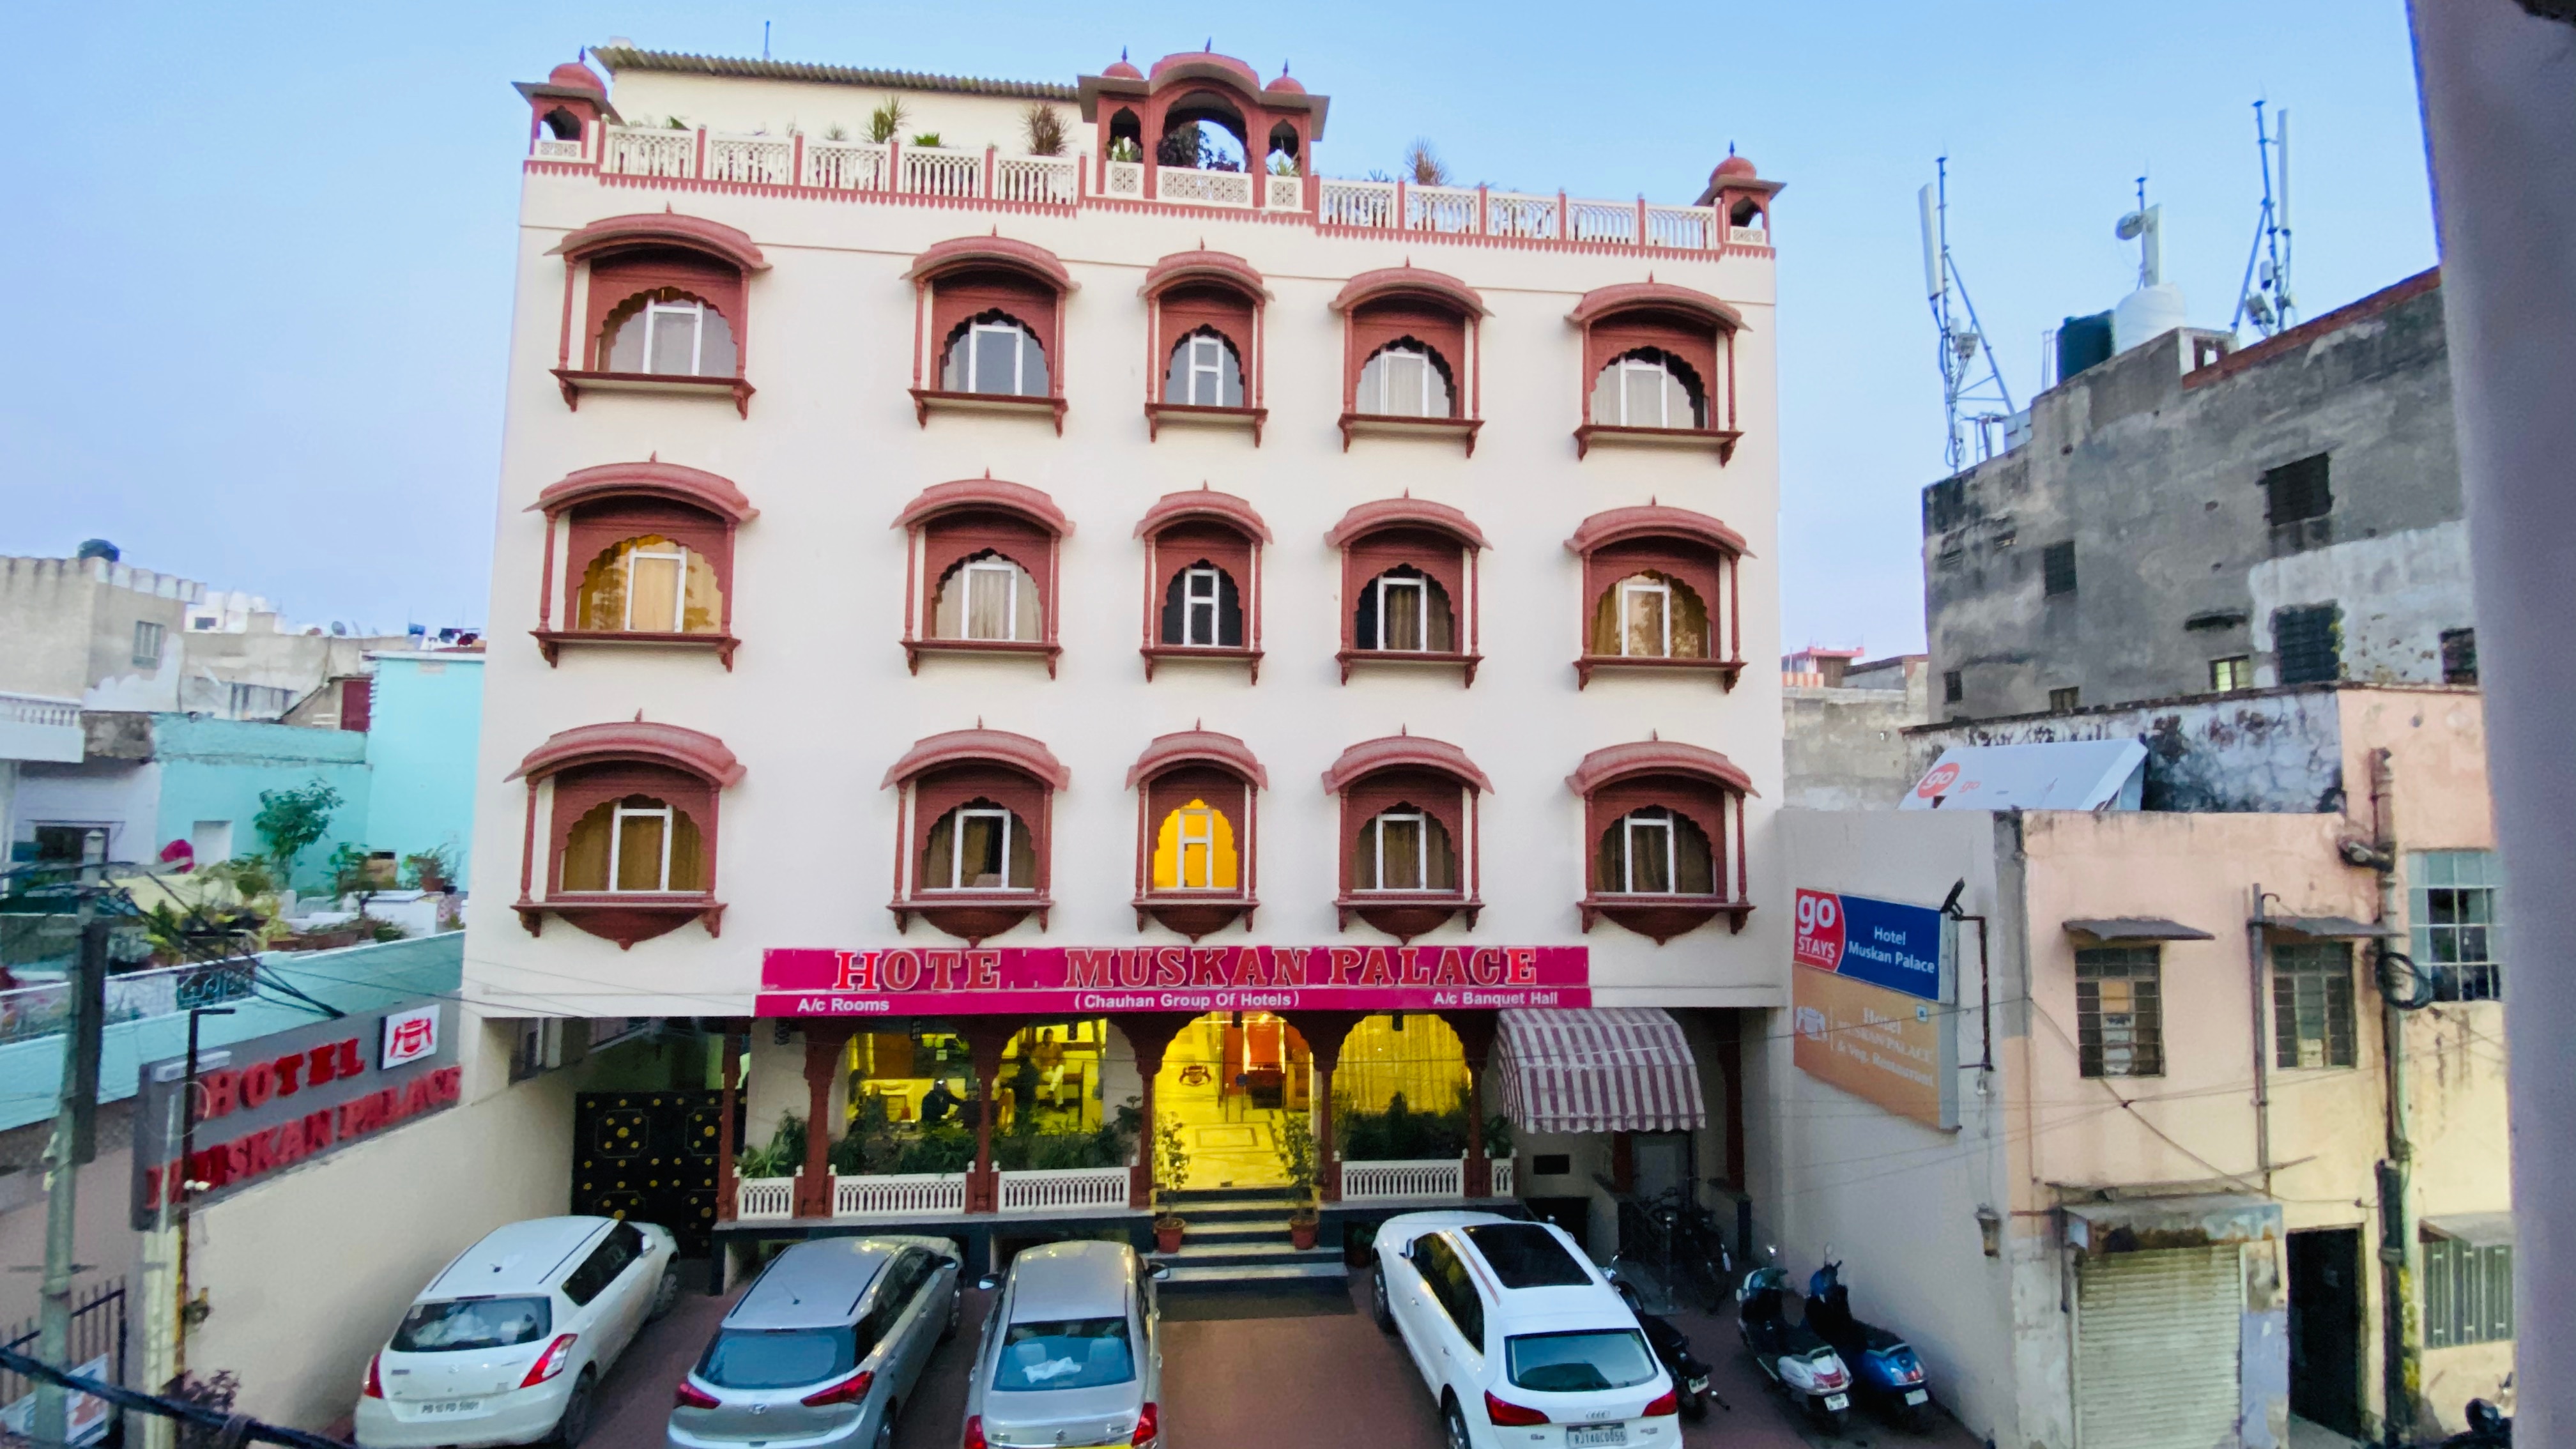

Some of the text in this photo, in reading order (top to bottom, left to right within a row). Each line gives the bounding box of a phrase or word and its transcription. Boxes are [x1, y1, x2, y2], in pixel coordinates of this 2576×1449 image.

[1922, 771, 1954, 790] go
[1798, 894, 1836, 935] go
[1874, 926, 1906, 946] Hotel
[1798, 936, 1836, 959] STAYS
[1848, 940, 1935, 974] Muskan Palace
[1064, 947, 1310, 988] MUSKAN
[1328, 946, 1537, 986] PALACE
[797, 997, 890, 1012] A/c Rooms
[1160, 993, 1210, 1009] Group
[1216, 992, 1236, 1006] Of
[1433, 991, 1558, 1007] A/c Banquet Hall
[194, 1038, 365, 1121] HOTEL
